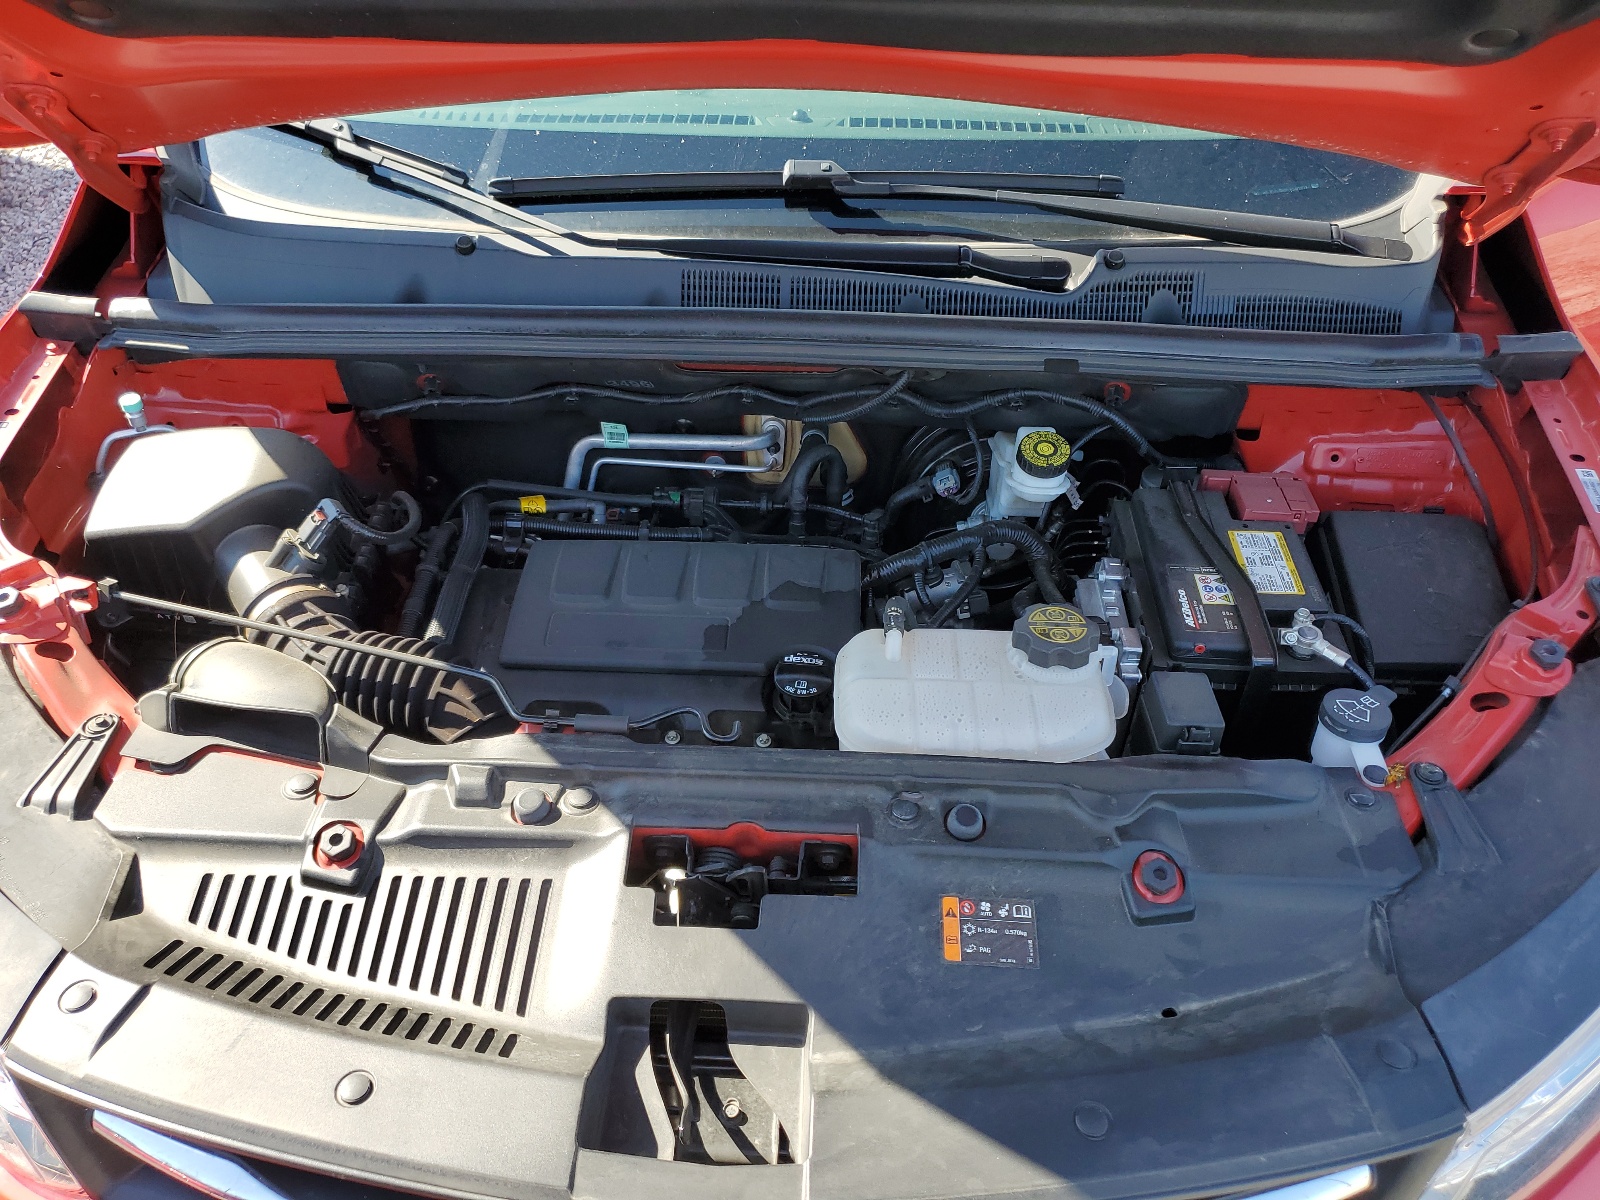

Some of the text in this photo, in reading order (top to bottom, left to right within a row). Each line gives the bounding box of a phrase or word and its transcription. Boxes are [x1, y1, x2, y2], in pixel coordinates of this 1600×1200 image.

[1178, 588, 1196, 628] ACDelco
[783, 654, 824, 666] dexos
[979, 946, 991, 954] PAG
